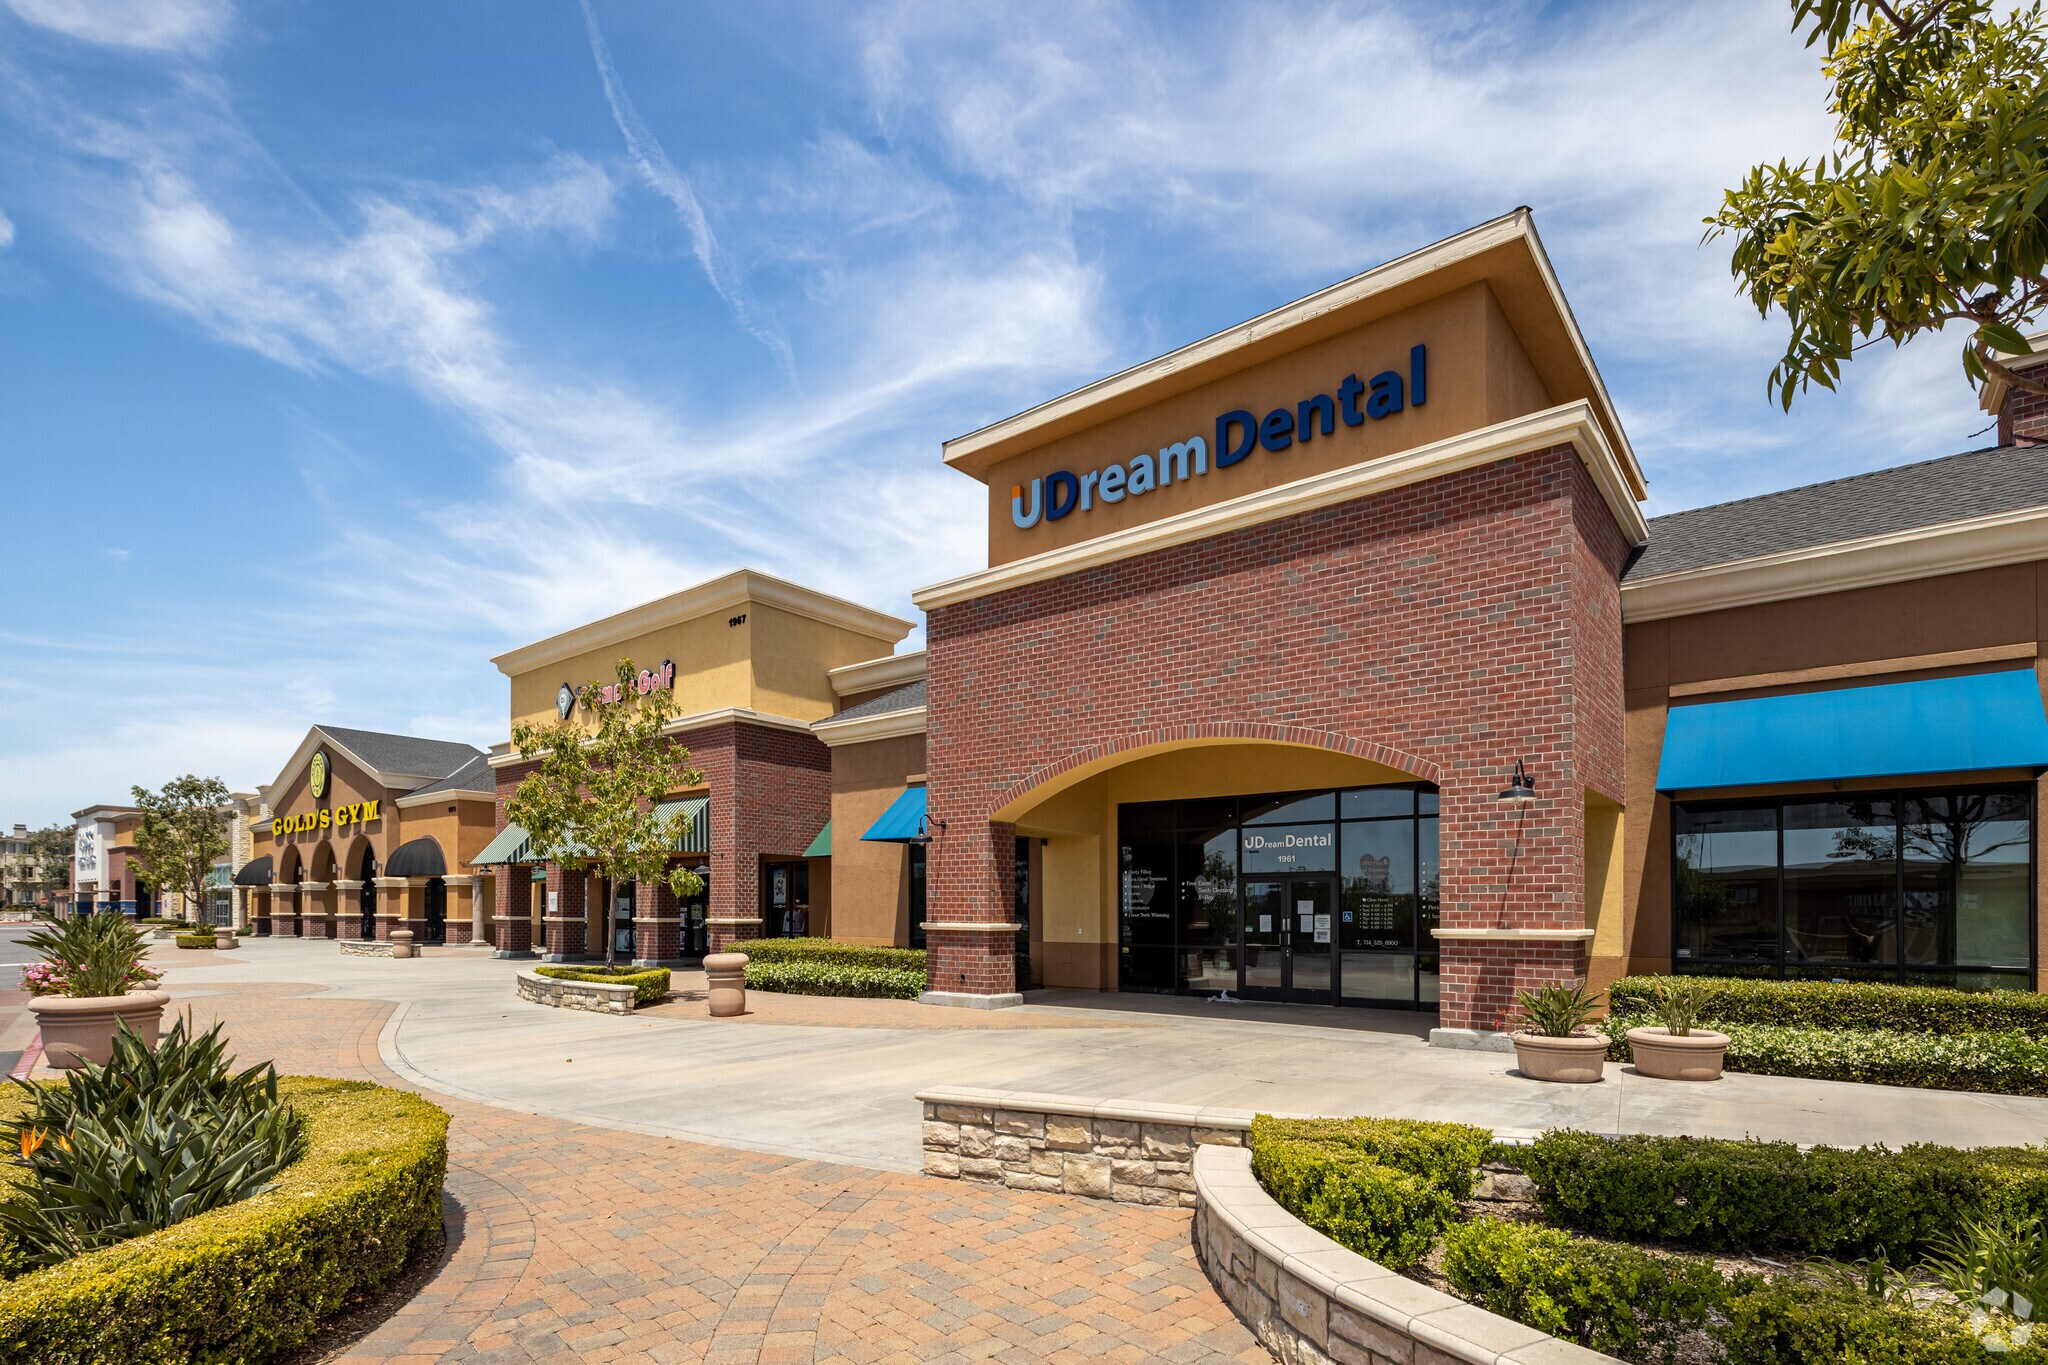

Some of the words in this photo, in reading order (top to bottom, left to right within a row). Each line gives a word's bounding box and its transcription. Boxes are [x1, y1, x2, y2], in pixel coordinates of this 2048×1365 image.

[1011, 434, 1208, 530] UDream
[1215, 343, 1427, 470] Dental
[728, 614, 747, 628] 1967
[638, 662, 675, 695] Golf
[271, 808, 330, 837] GOLD'S
[335, 799, 380, 827] GYM
[1285, 833, 1332, 848] Dental
[1277, 855, 1296, 863] 1961
